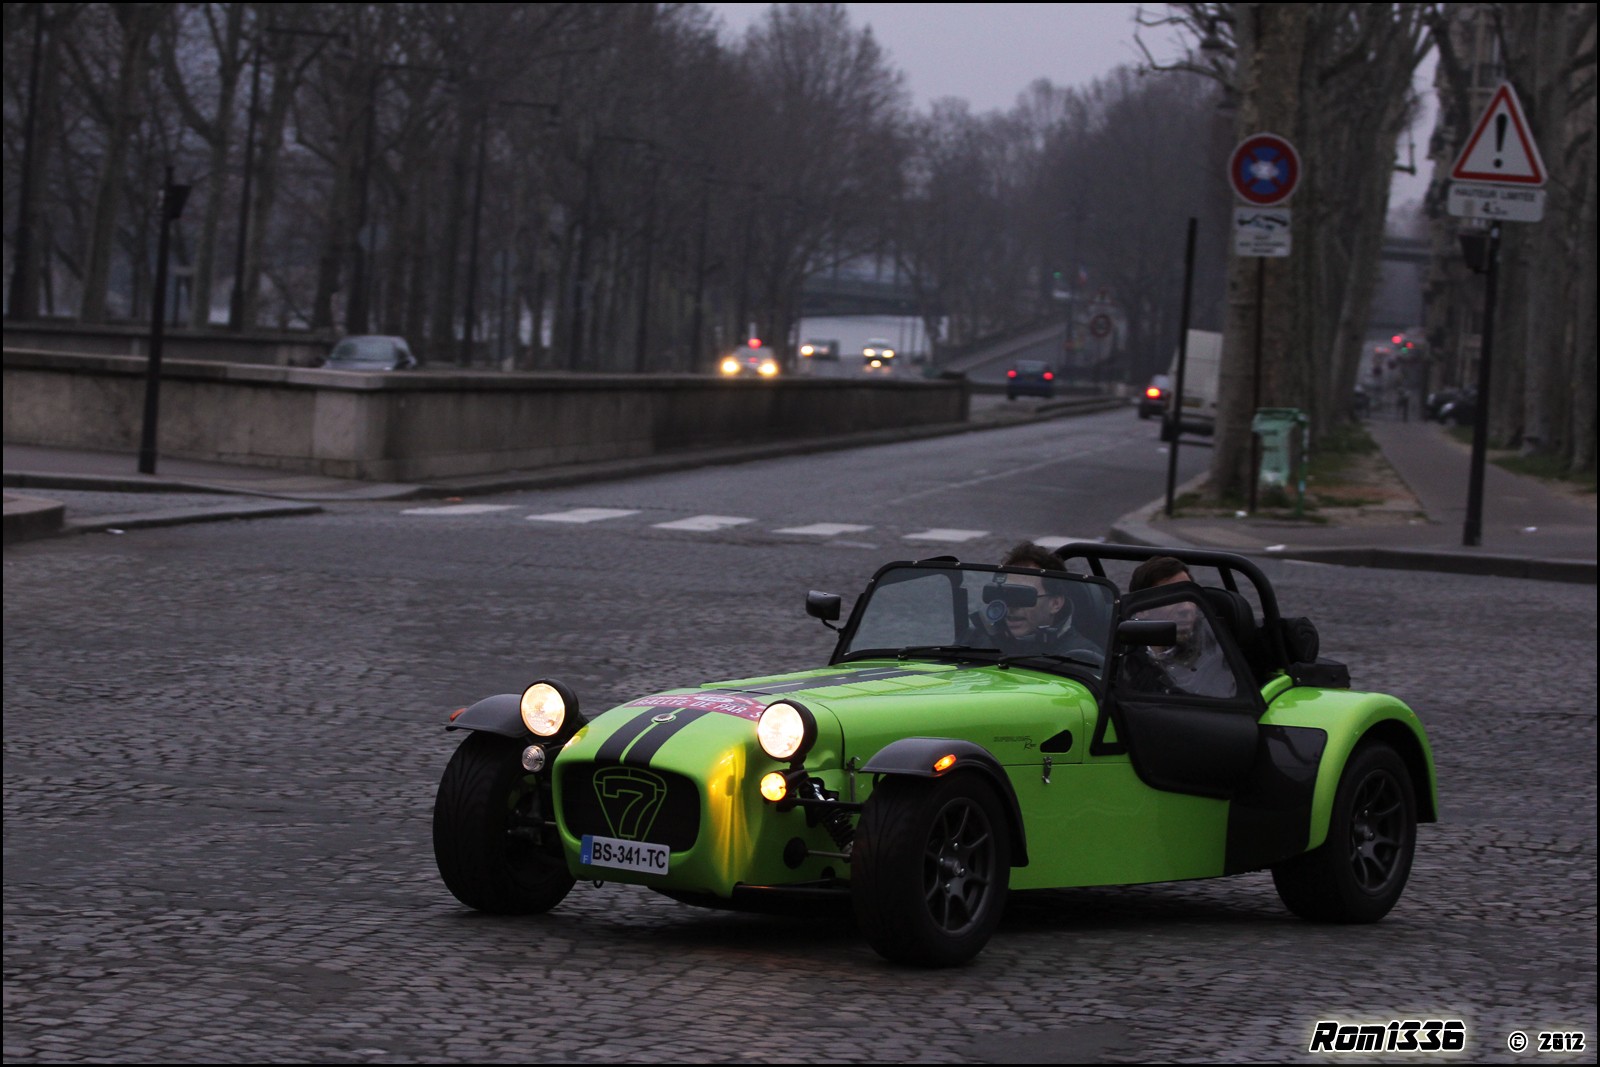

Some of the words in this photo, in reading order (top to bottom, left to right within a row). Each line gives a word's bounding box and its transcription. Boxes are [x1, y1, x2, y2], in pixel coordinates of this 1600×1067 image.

[689, 700, 717, 709] DE
[602, 775, 657, 838] 7
[582, 854, 589, 864] F
[592, 841, 666, 869] BS-341-TC
